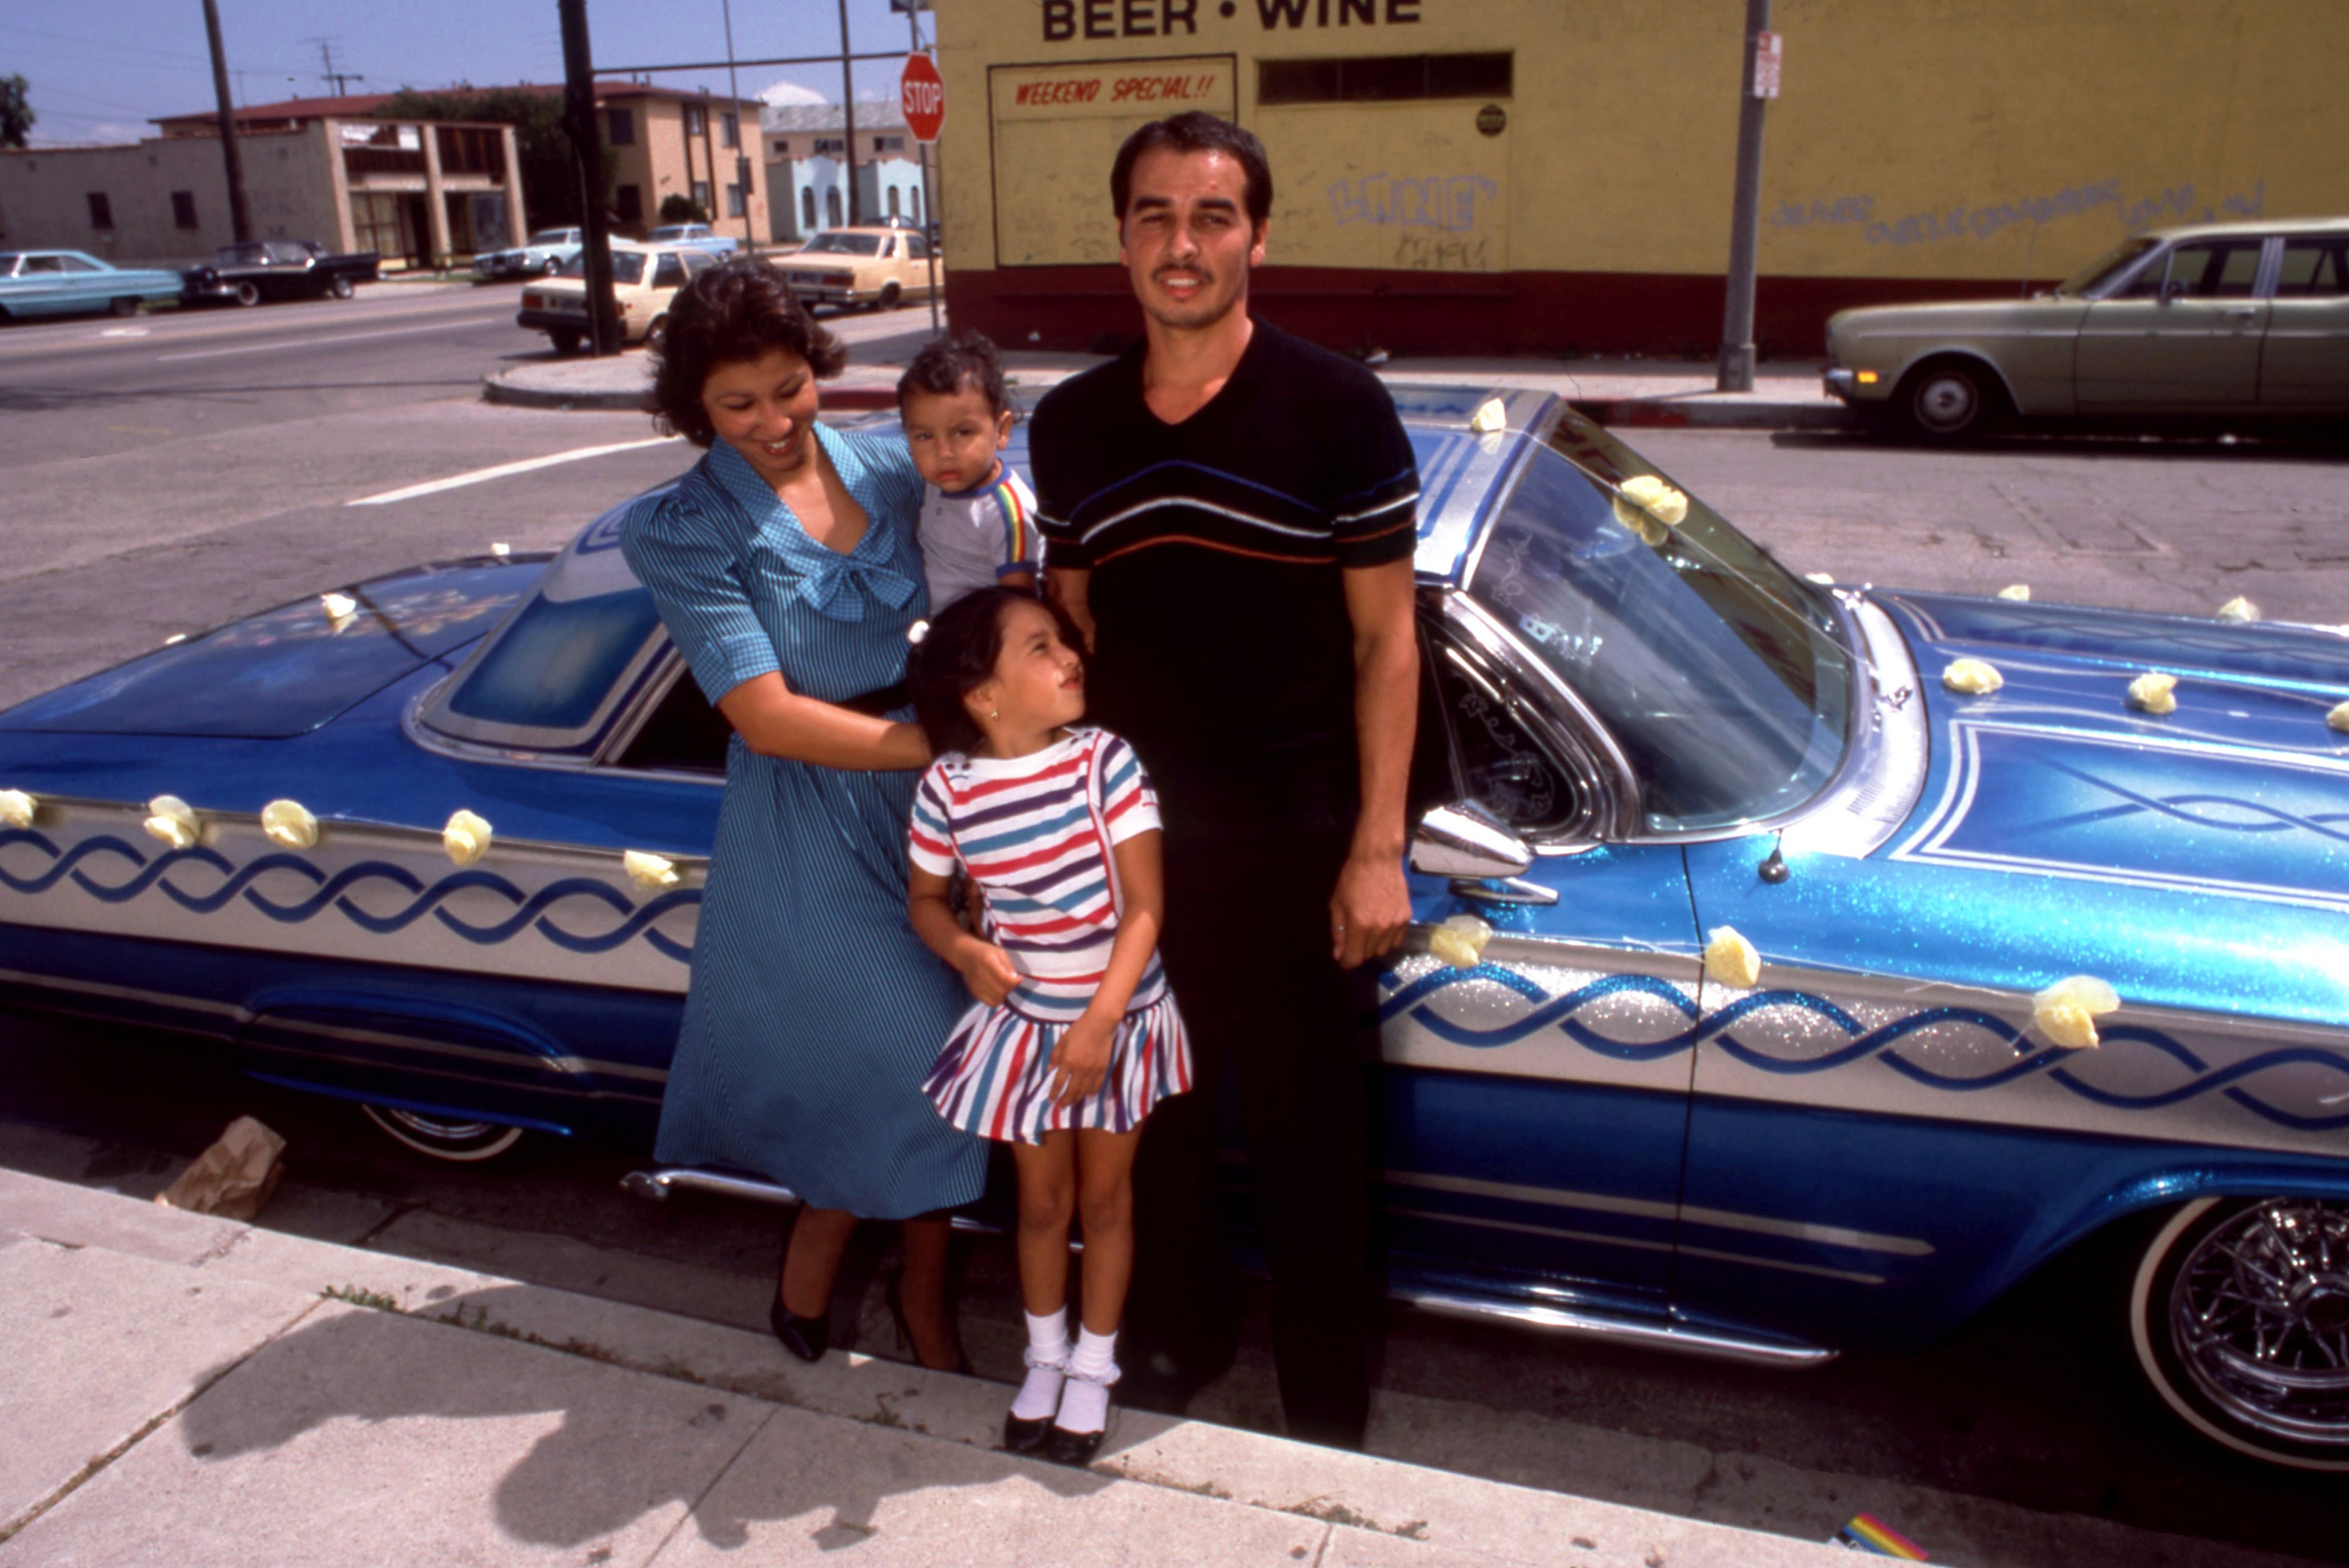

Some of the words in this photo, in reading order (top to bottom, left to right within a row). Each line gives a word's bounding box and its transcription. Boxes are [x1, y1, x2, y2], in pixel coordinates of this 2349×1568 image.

[1043, 0, 1198, 41] BEER
[1257, 0, 1421, 30] WINE
[904, 81, 941, 114] STOP
[1016, 79, 1101, 106] WEEKEND
[1111, 75, 1216, 102] SPECIAL!!
